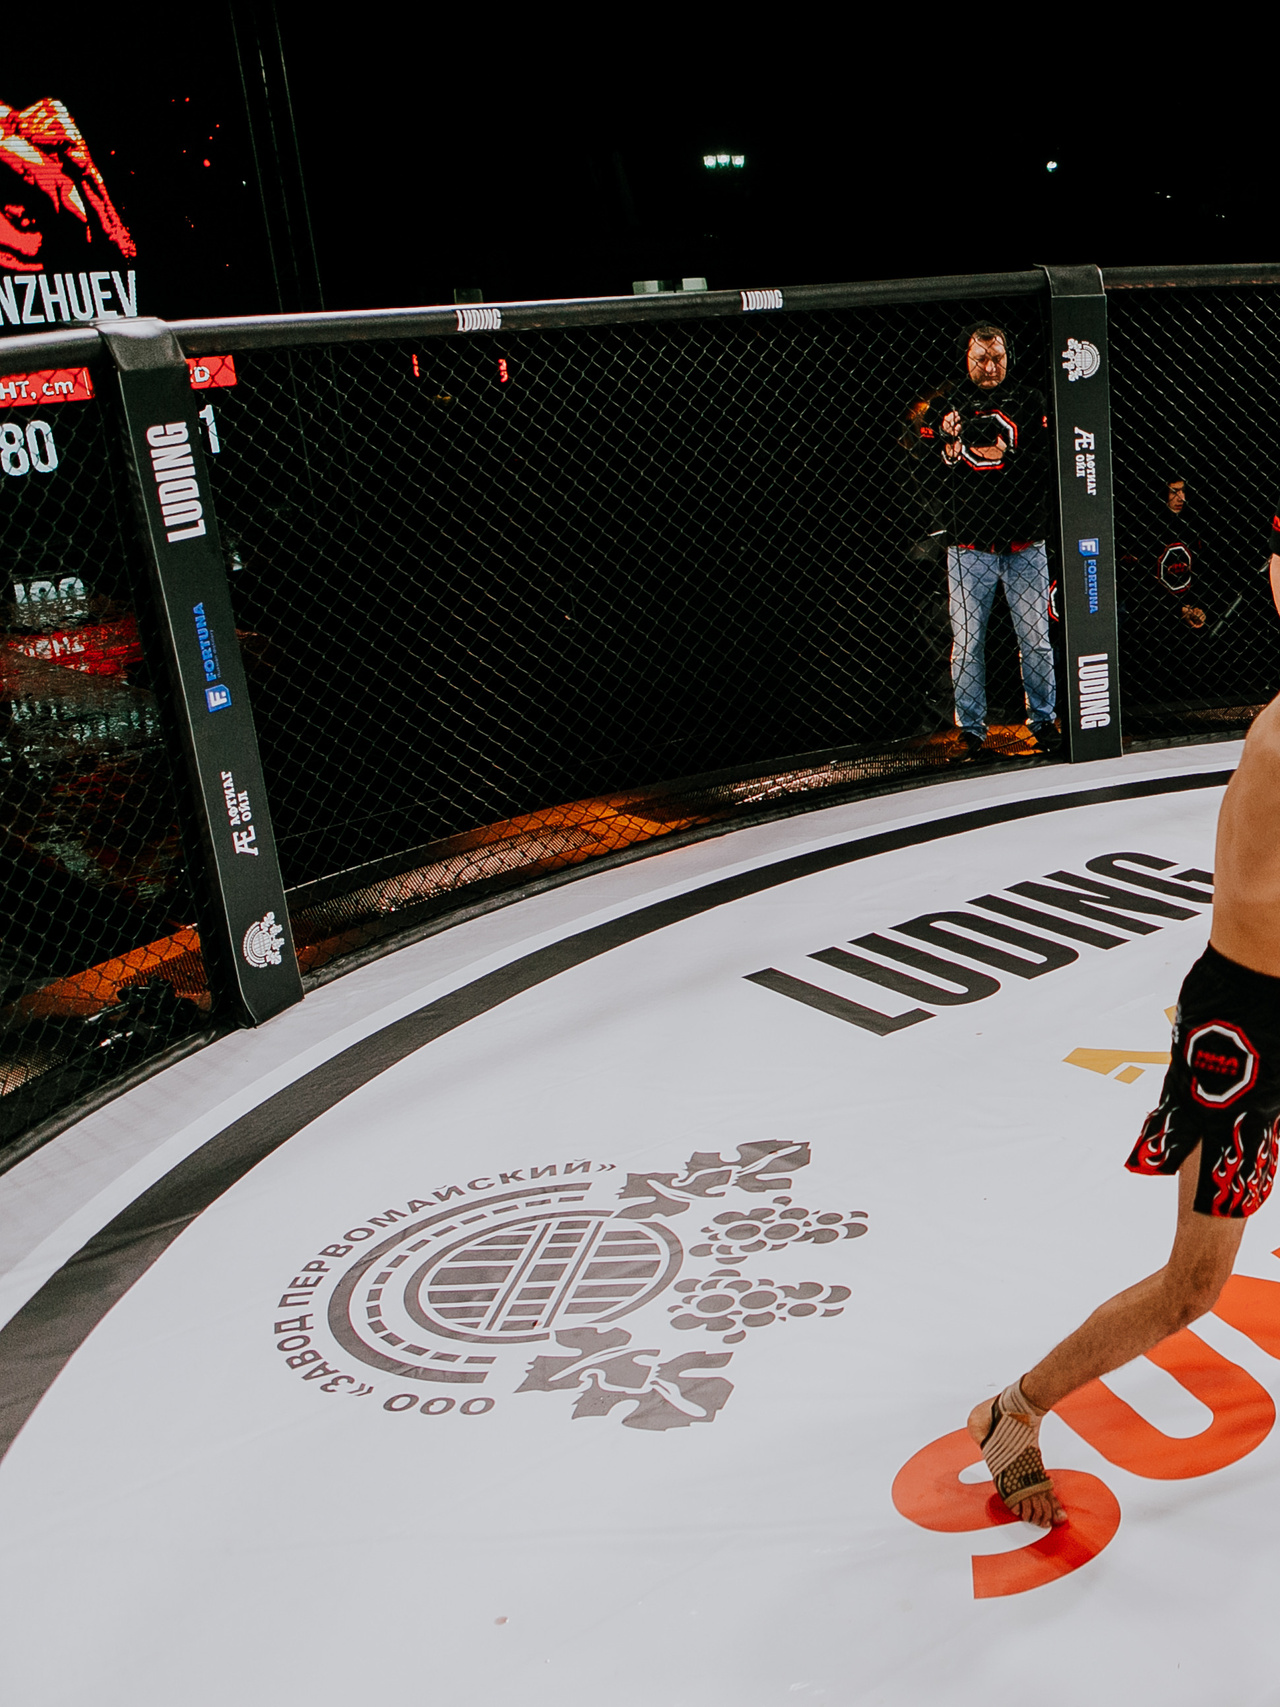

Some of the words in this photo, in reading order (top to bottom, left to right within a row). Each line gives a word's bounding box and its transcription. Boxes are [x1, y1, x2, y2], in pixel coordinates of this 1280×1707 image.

[455, 308, 502, 332] LUDING
[740, 289, 783, 311] LUDING
[42, 380, 74, 397] cm
[146, 421, 207, 543] LUDING
[1087, 559, 1098, 614] FORTUNA
[192, 602, 218, 682] FORTUNA
[1077, 652, 1111, 730] LUDING
[741, 851, 1216, 1037] LUDING
